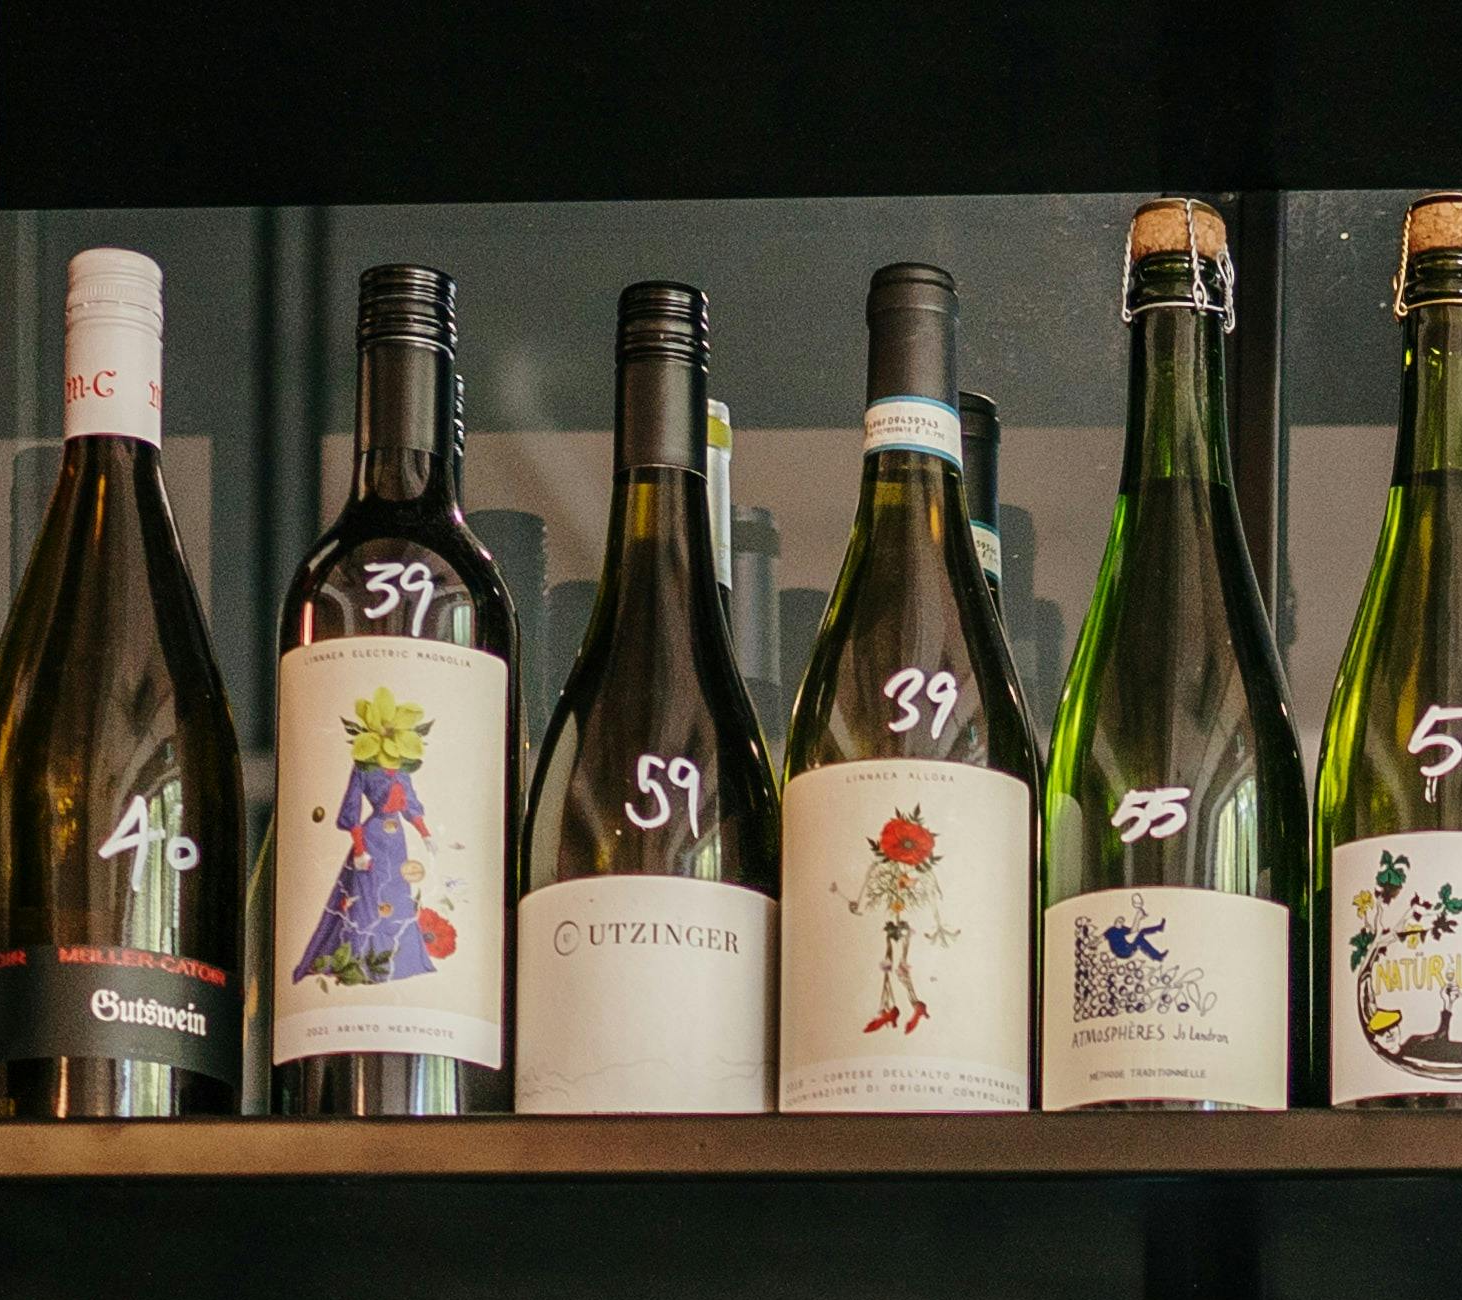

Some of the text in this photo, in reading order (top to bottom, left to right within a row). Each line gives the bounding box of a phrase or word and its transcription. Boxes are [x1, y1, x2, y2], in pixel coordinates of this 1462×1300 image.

[363, 560, 438, 638] 39
[883, 667, 959, 741] 39
[624, 753, 701, 839] 59
[1111, 786, 1191, 843] 55
[97, 794, 200, 892] 40
[589, 923, 740, 955] UTZINGER
[90, 988, 209, 1037] Gutswein
